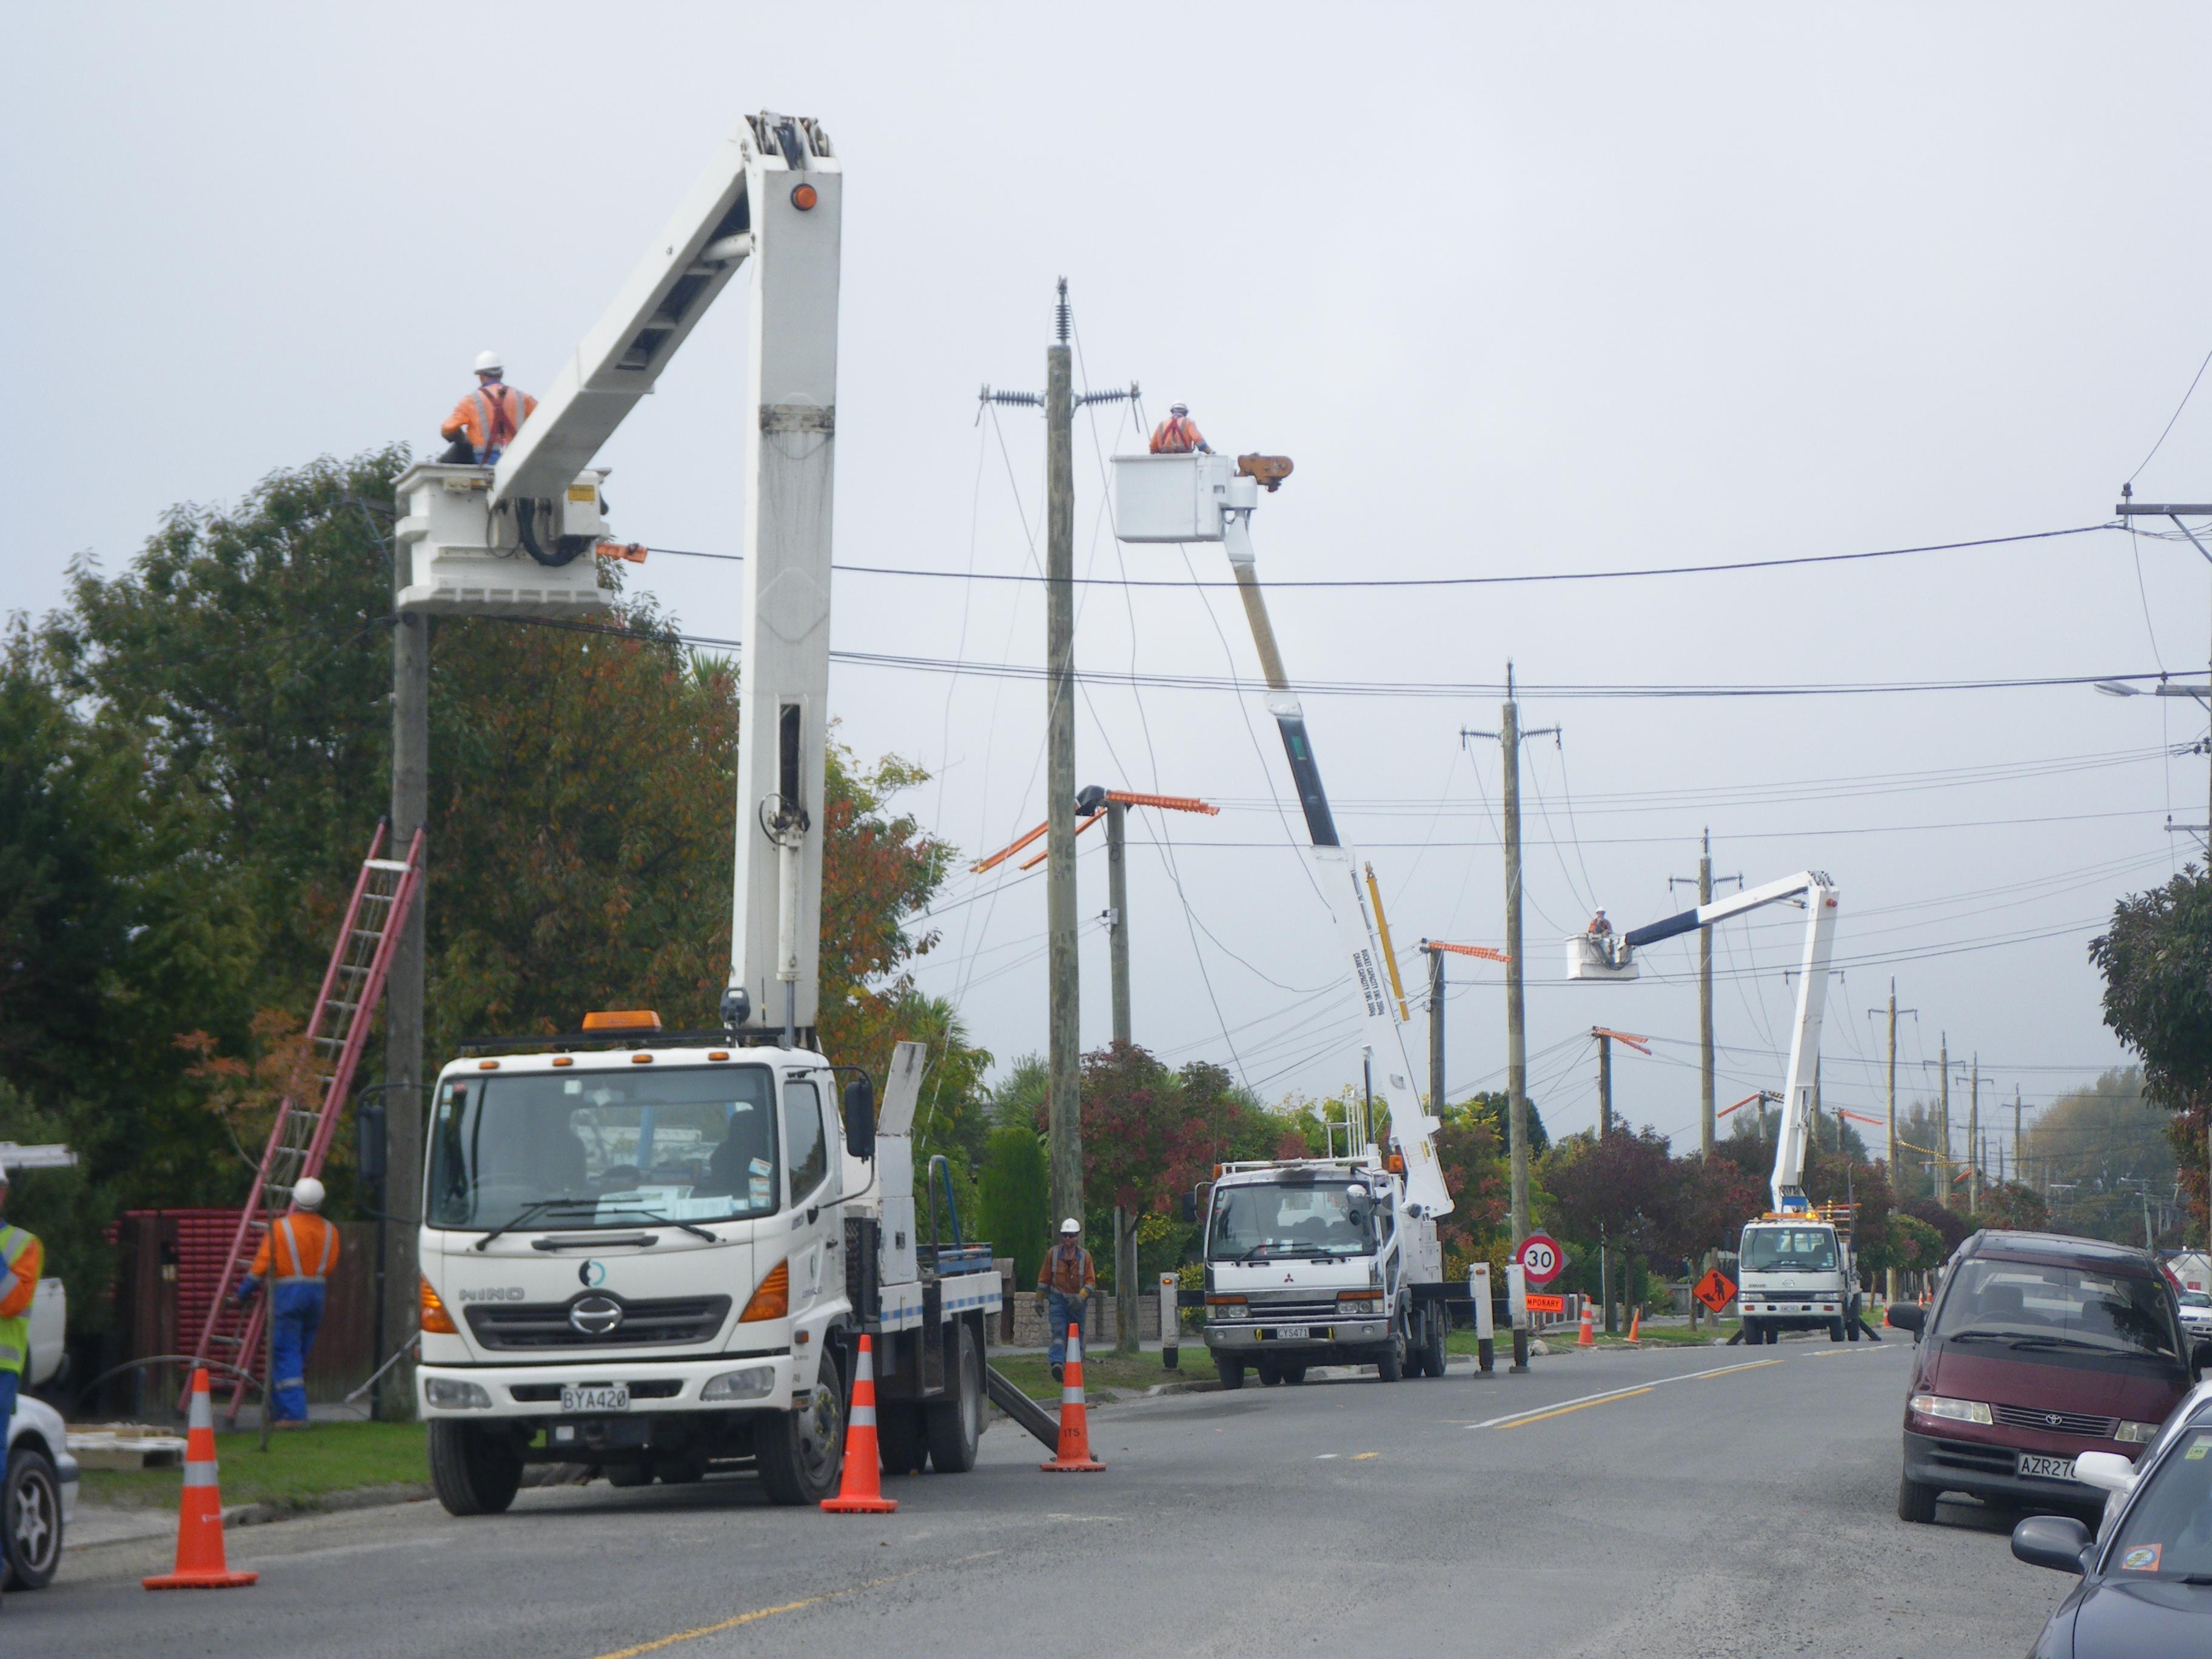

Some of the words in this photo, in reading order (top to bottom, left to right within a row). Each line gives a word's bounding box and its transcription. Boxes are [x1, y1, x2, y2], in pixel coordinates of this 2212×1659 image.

[1353, 953, 1363, 968] CRANE
[1358, 968, 1369, 990] CAPACITY
[1361, 949, 1372, 967] BUCKET
[1367, 967, 1378, 988] CAPACITY
[1527, 1250, 1552, 1267] 30
[459, 1287, 525, 1301] HINO
[1527, 1299, 1559, 1307] MPORARY
[1278, 1328, 1307, 1338] CYS471
[563, 1390, 626, 1408] BYA420
